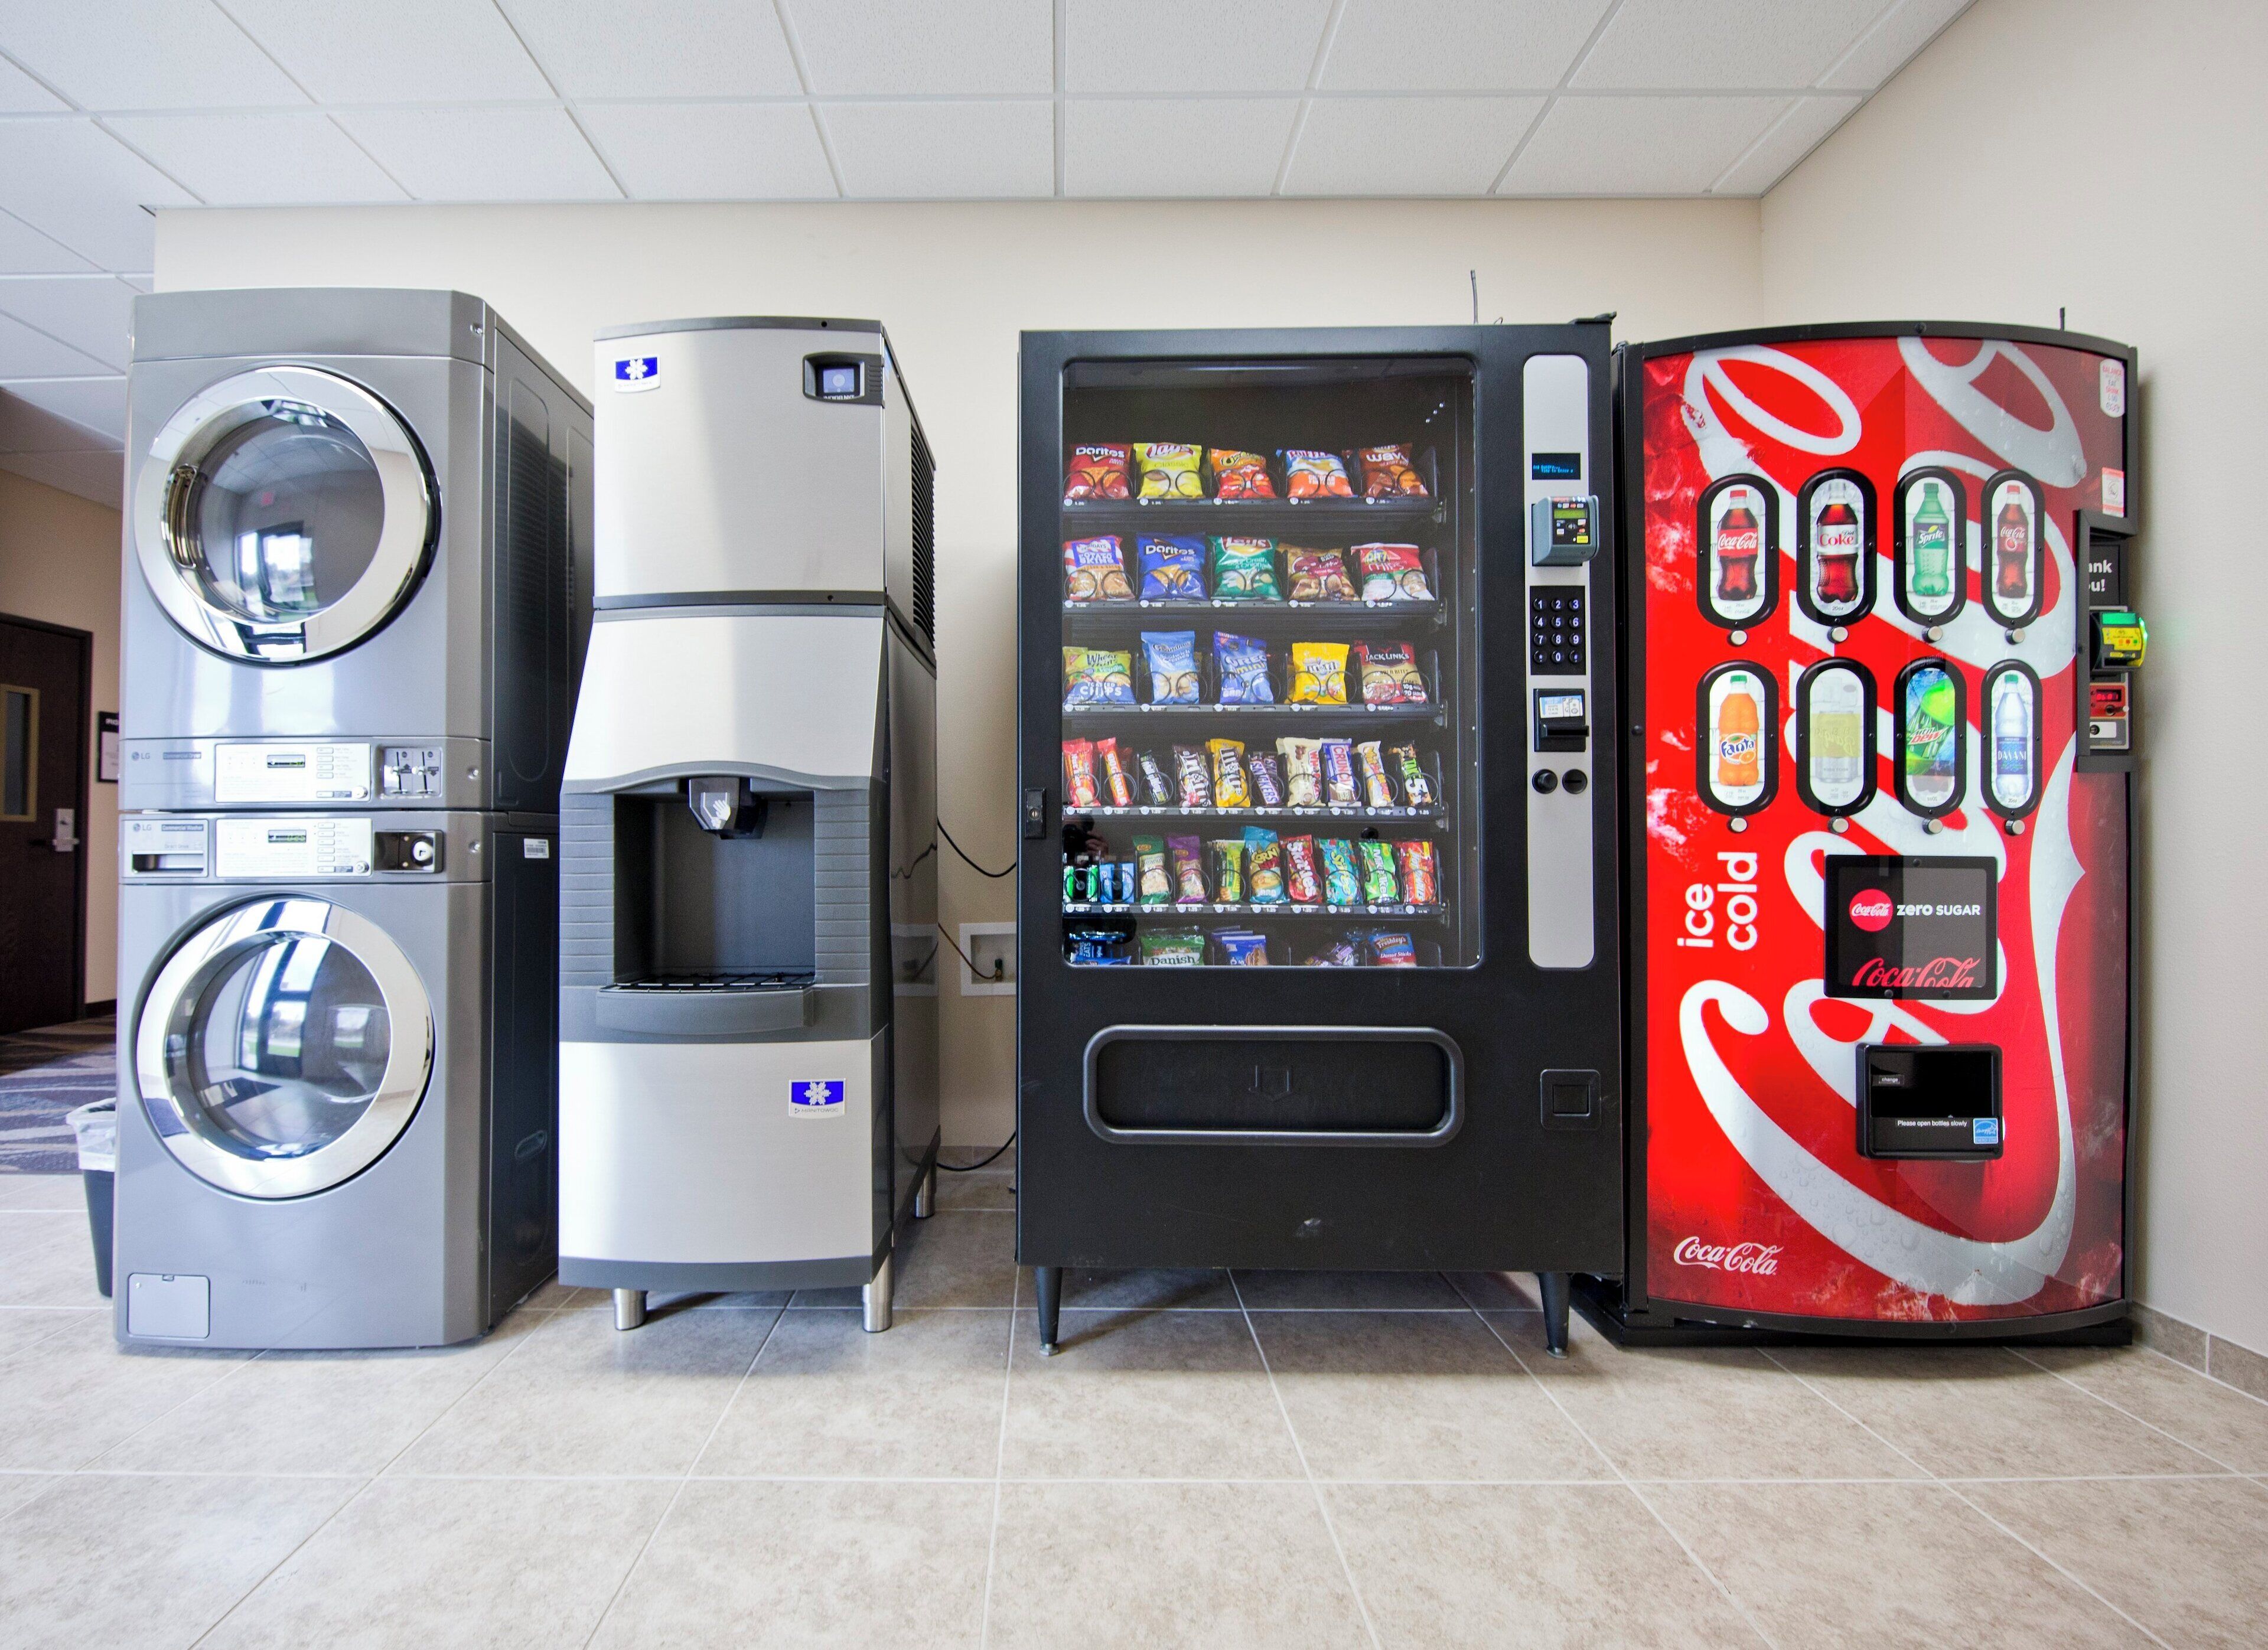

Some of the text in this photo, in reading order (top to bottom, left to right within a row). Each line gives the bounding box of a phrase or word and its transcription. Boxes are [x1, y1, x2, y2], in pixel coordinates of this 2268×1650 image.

[1076, 447, 1125, 459] Doritos
[1918, 529, 1944, 544] Sprite
[2000, 526, 2025, 539] Coca-Cola
[1718, 531, 1758, 550] Coca-Cola
[1819, 533, 1854, 547] Coke
[1145, 544, 1195, 555] Doritos
[1537, 599, 1579, 609] 1 2 3
[1537, 618, 1579, 627] 4 5 6
[1538, 635, 1579, 644] 7 8 9
[1365, 653, 1385, 661] JACK
[1555, 653, 1561, 661] 0
[1080, 685, 1122, 697] CHIPS
[1721, 738, 1755, 758] Fanta
[1997, 751, 2027, 760] DASANI
[1250, 760, 1279, 805] SNICKERS
[1250, 843, 1280, 863] CORN
[1286, 841, 1317, 897] Skittles
[1716, 851, 1758, 951] cold
[1677, 883, 1715, 948] ice
[1851, 902, 1981, 917] Coca-Cola zero SUGAR
[1376, 936, 1407, 949] Freshley's
[1151, 954, 1195, 966] Danish
[1852, 957, 1981, 988] Coca-Cola
[1950, 1120, 1967, 1128] slowly
[1673, 1235, 1784, 1276] Coca-Cola
